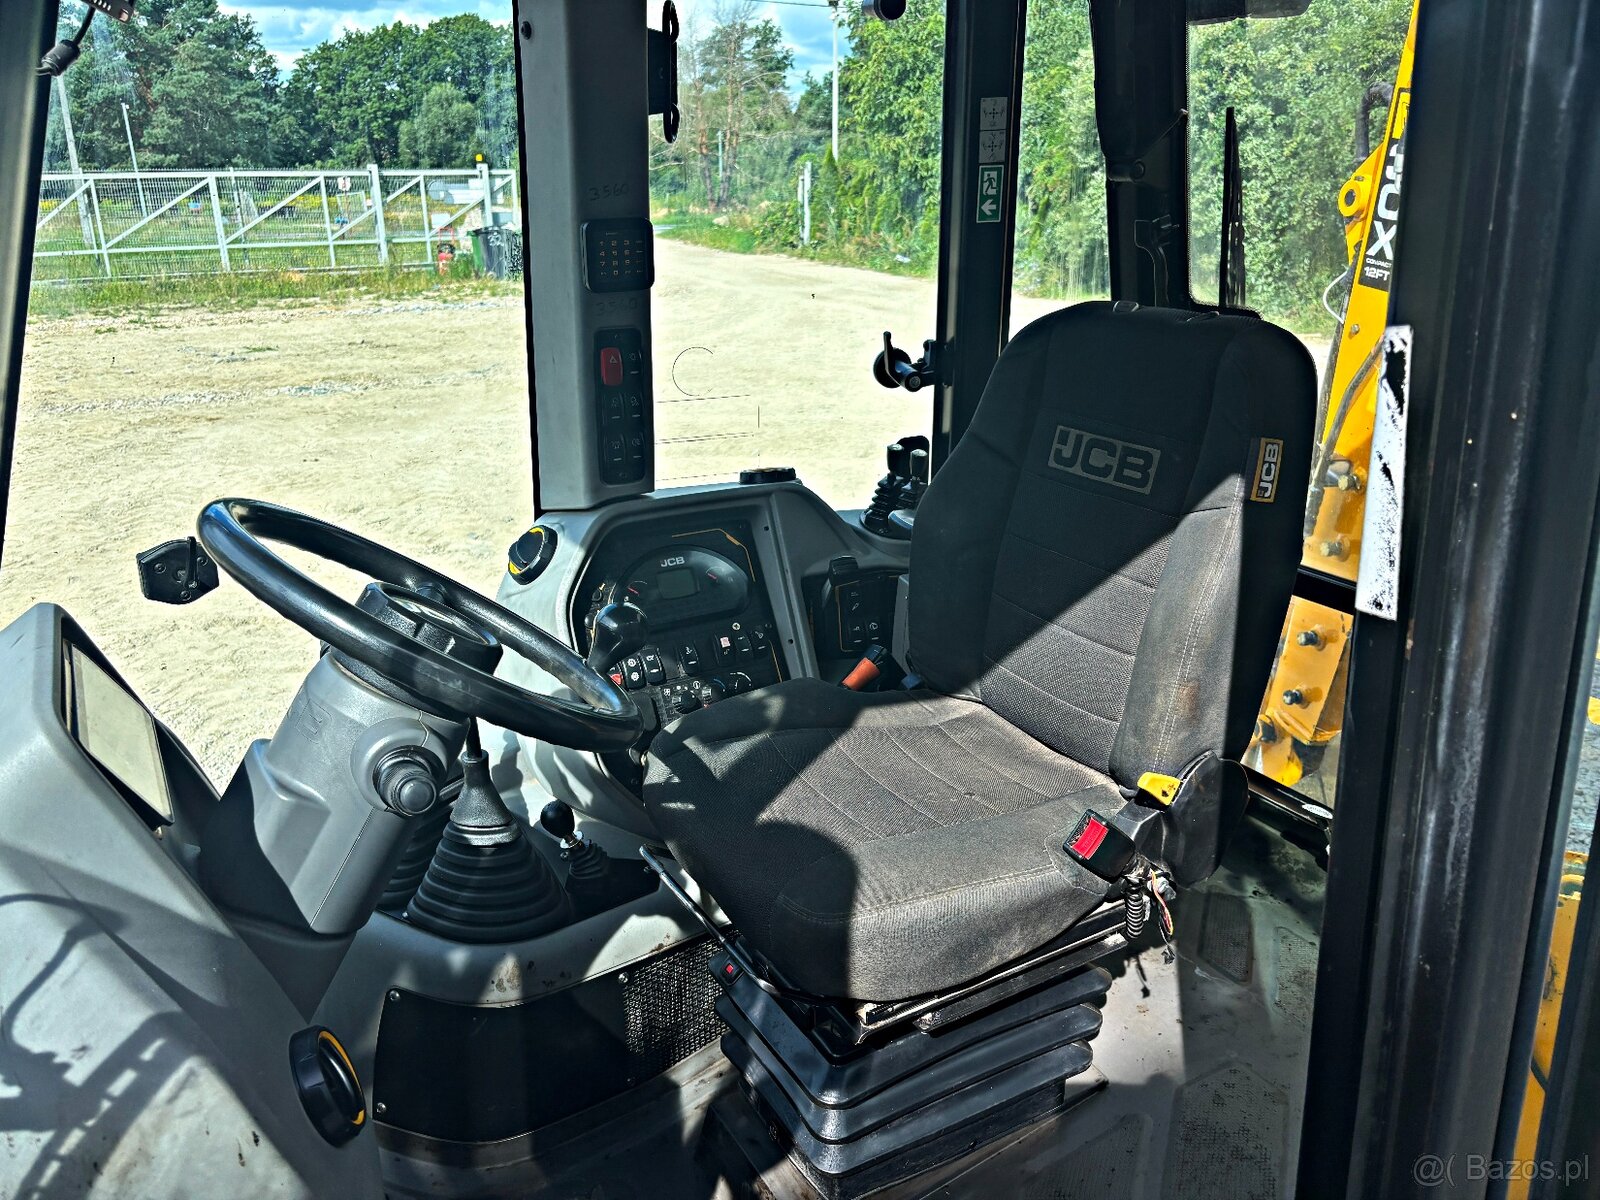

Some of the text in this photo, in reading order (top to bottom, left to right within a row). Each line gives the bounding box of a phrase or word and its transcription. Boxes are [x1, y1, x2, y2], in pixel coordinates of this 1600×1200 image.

[1364, 266, 1391, 281] 12FT
[1051, 428, 1155, 490] JCB
[1256, 442, 1280, 498] JCB
[660, 556, 686, 568] JCB
